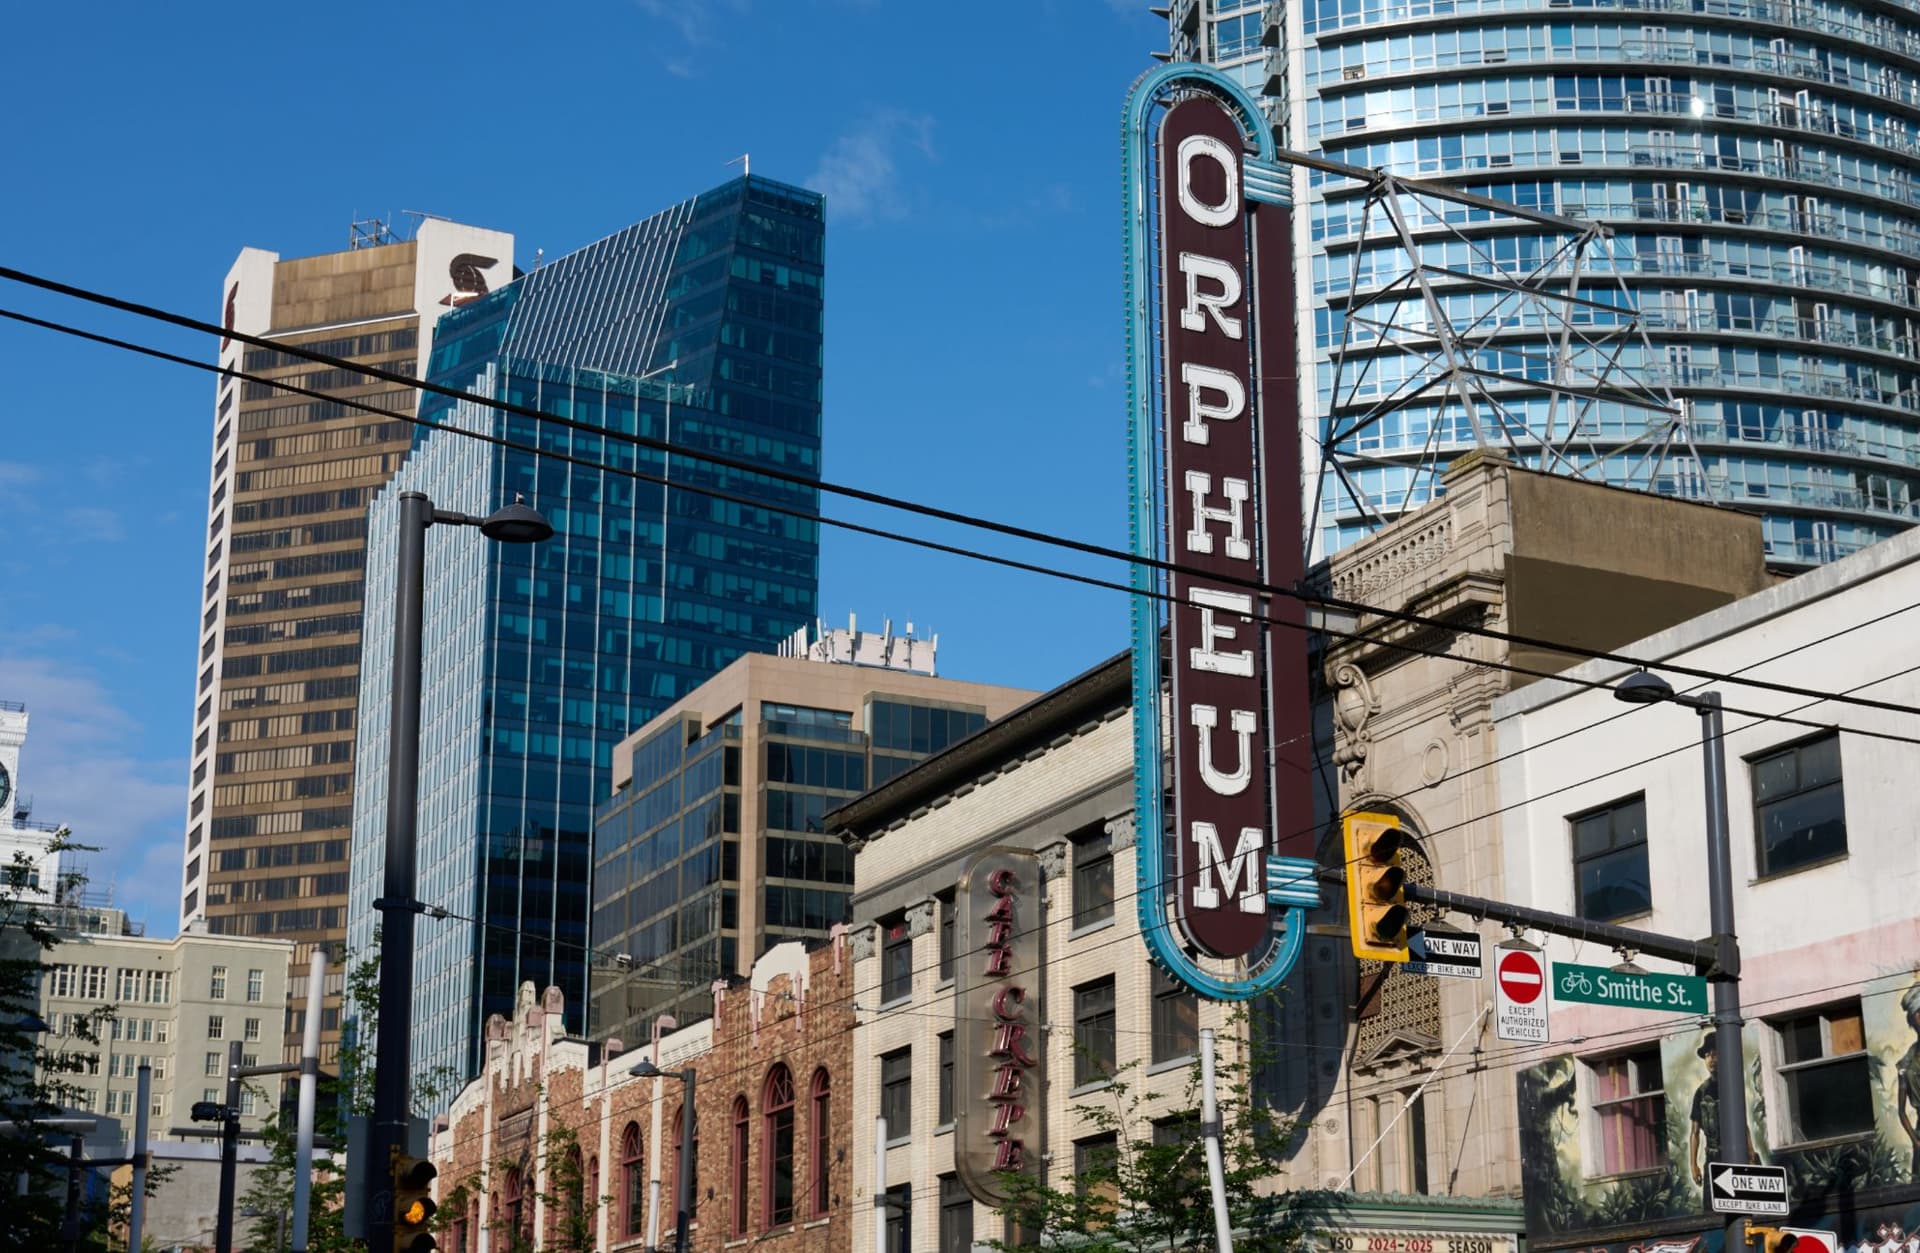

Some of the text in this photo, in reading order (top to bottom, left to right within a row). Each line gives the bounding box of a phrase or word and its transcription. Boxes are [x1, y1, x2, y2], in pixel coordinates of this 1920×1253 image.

[1176, 134, 1266, 915] ORPHEUM
[1424, 939, 1477, 955] ONE WAY
[1437, 963, 1454, 974] BIKE
[1457, 966, 1477, 977] LANE
[1597, 975, 1692, 1006] Smithe St.
[1508, 1006, 1535, 1017] EXCEPT
[1501, 1016, 1546, 1028] AUTHORIZED
[1506, 1026, 1541, 1038] VEHICLES
[1731, 1176, 1781, 1191] ONE WAY
[1718, 1200, 1782, 1211] EXCEPT BIKE LANE
[1330, 1237, 1493, 1253] VSO 2024-2025 SEASON
